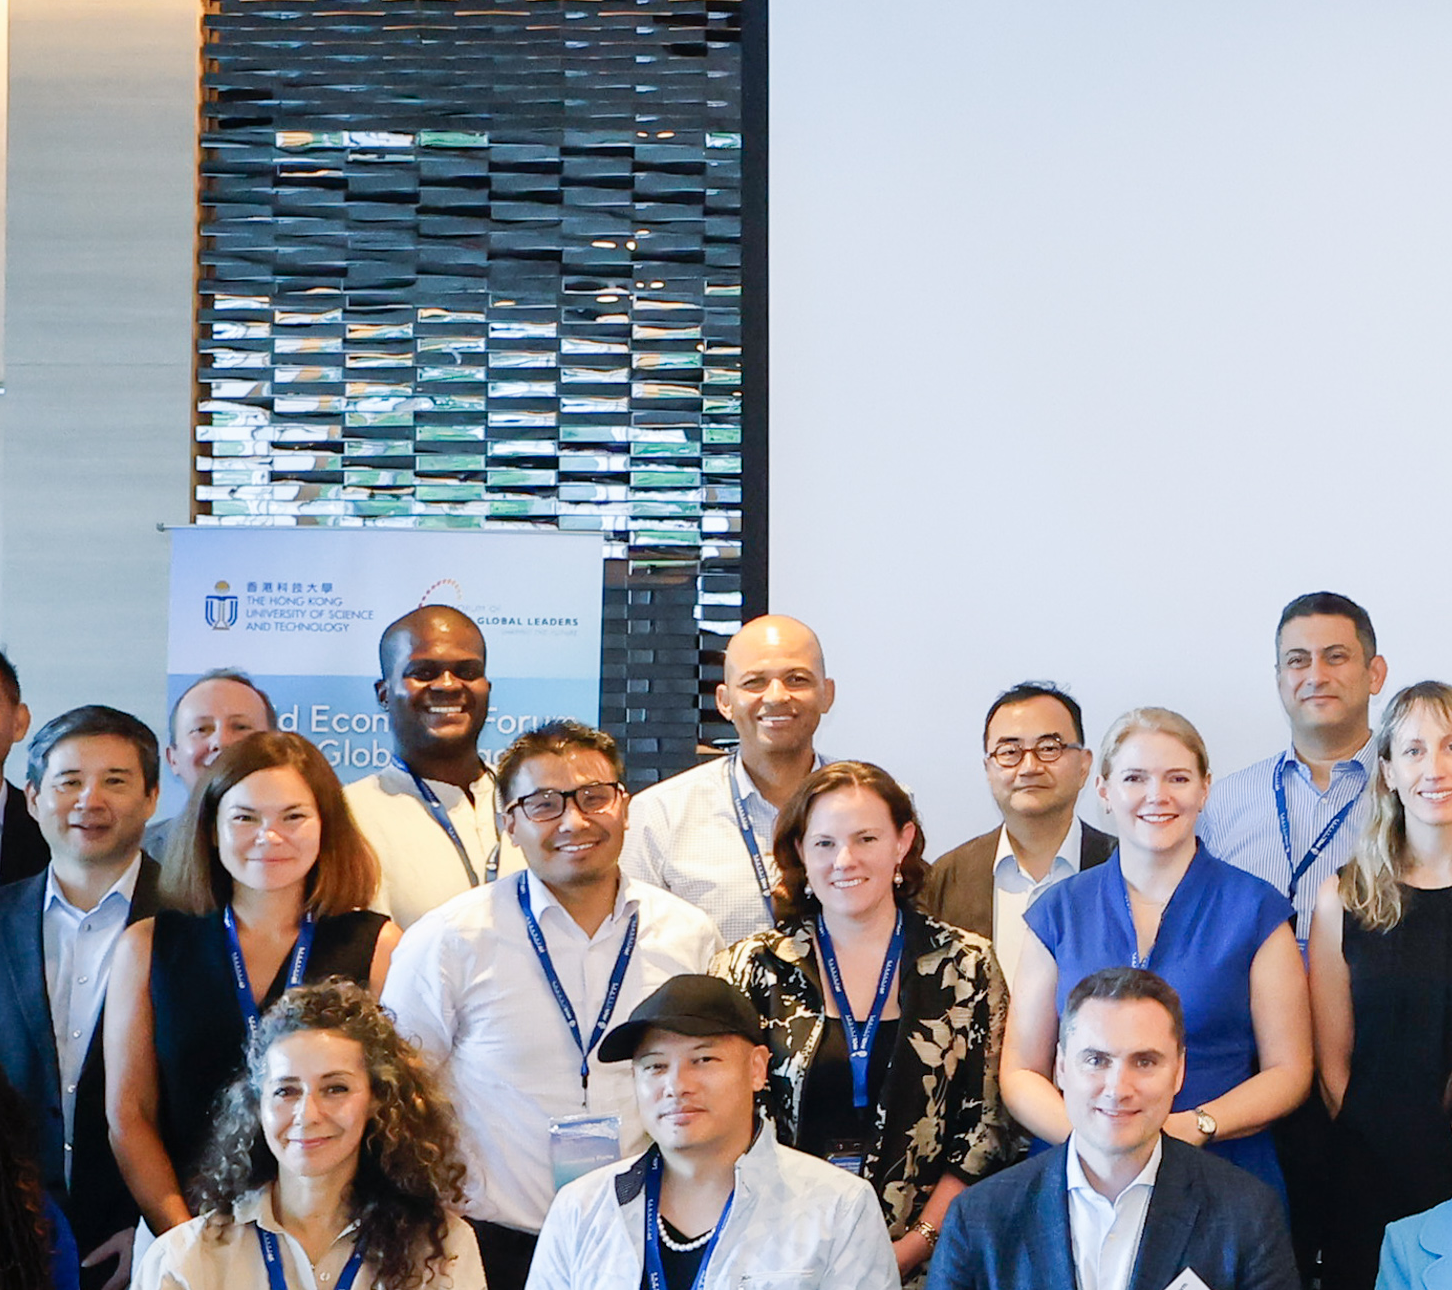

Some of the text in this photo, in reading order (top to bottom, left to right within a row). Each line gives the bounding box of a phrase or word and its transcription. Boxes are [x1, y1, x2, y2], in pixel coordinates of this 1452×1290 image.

[246, 595, 343, 607] THE HONG KONG
[245, 609, 374, 620] UNIVERSITY OF SCIENCE
[245, 621, 350, 632] AND TECHNOLOGY
[476, 616, 579, 627] GLOBAL LEADERS
[310, 704, 390, 734] Econ
[317, 738, 392, 768] Glob
